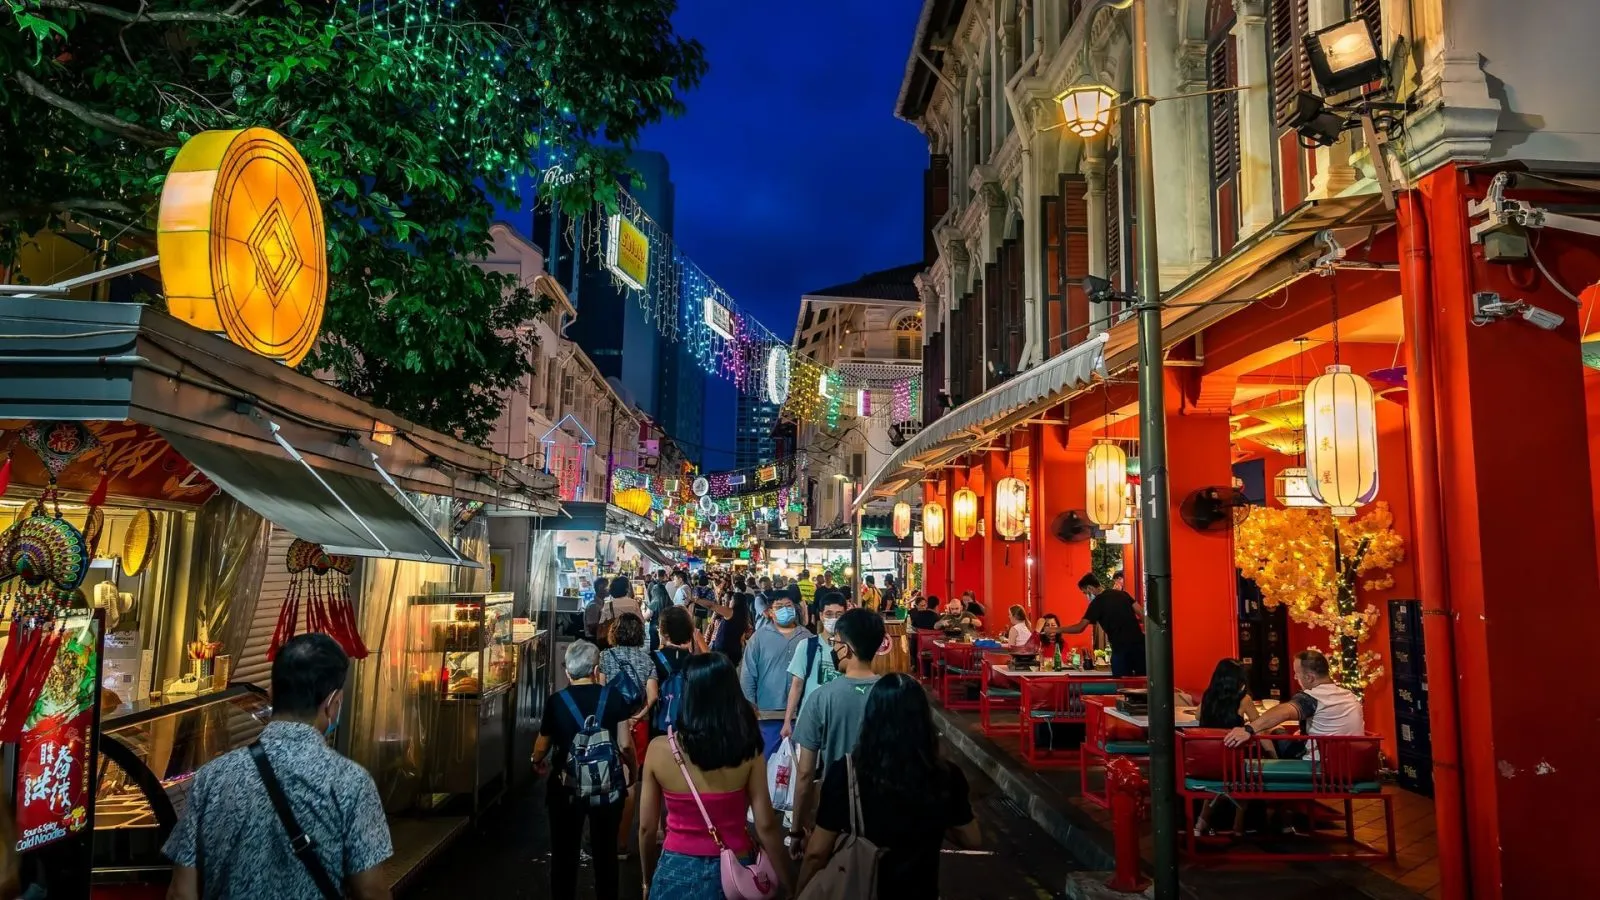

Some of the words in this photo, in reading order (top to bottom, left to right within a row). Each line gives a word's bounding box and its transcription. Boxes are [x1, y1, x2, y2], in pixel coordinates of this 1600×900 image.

[1147, 474, 1157, 519] 11
[16, 836, 34, 852] Cold
[34, 828, 67, 845] Noodles
[23, 828, 38, 838] Sour
[43, 821, 58, 833] Spicy
